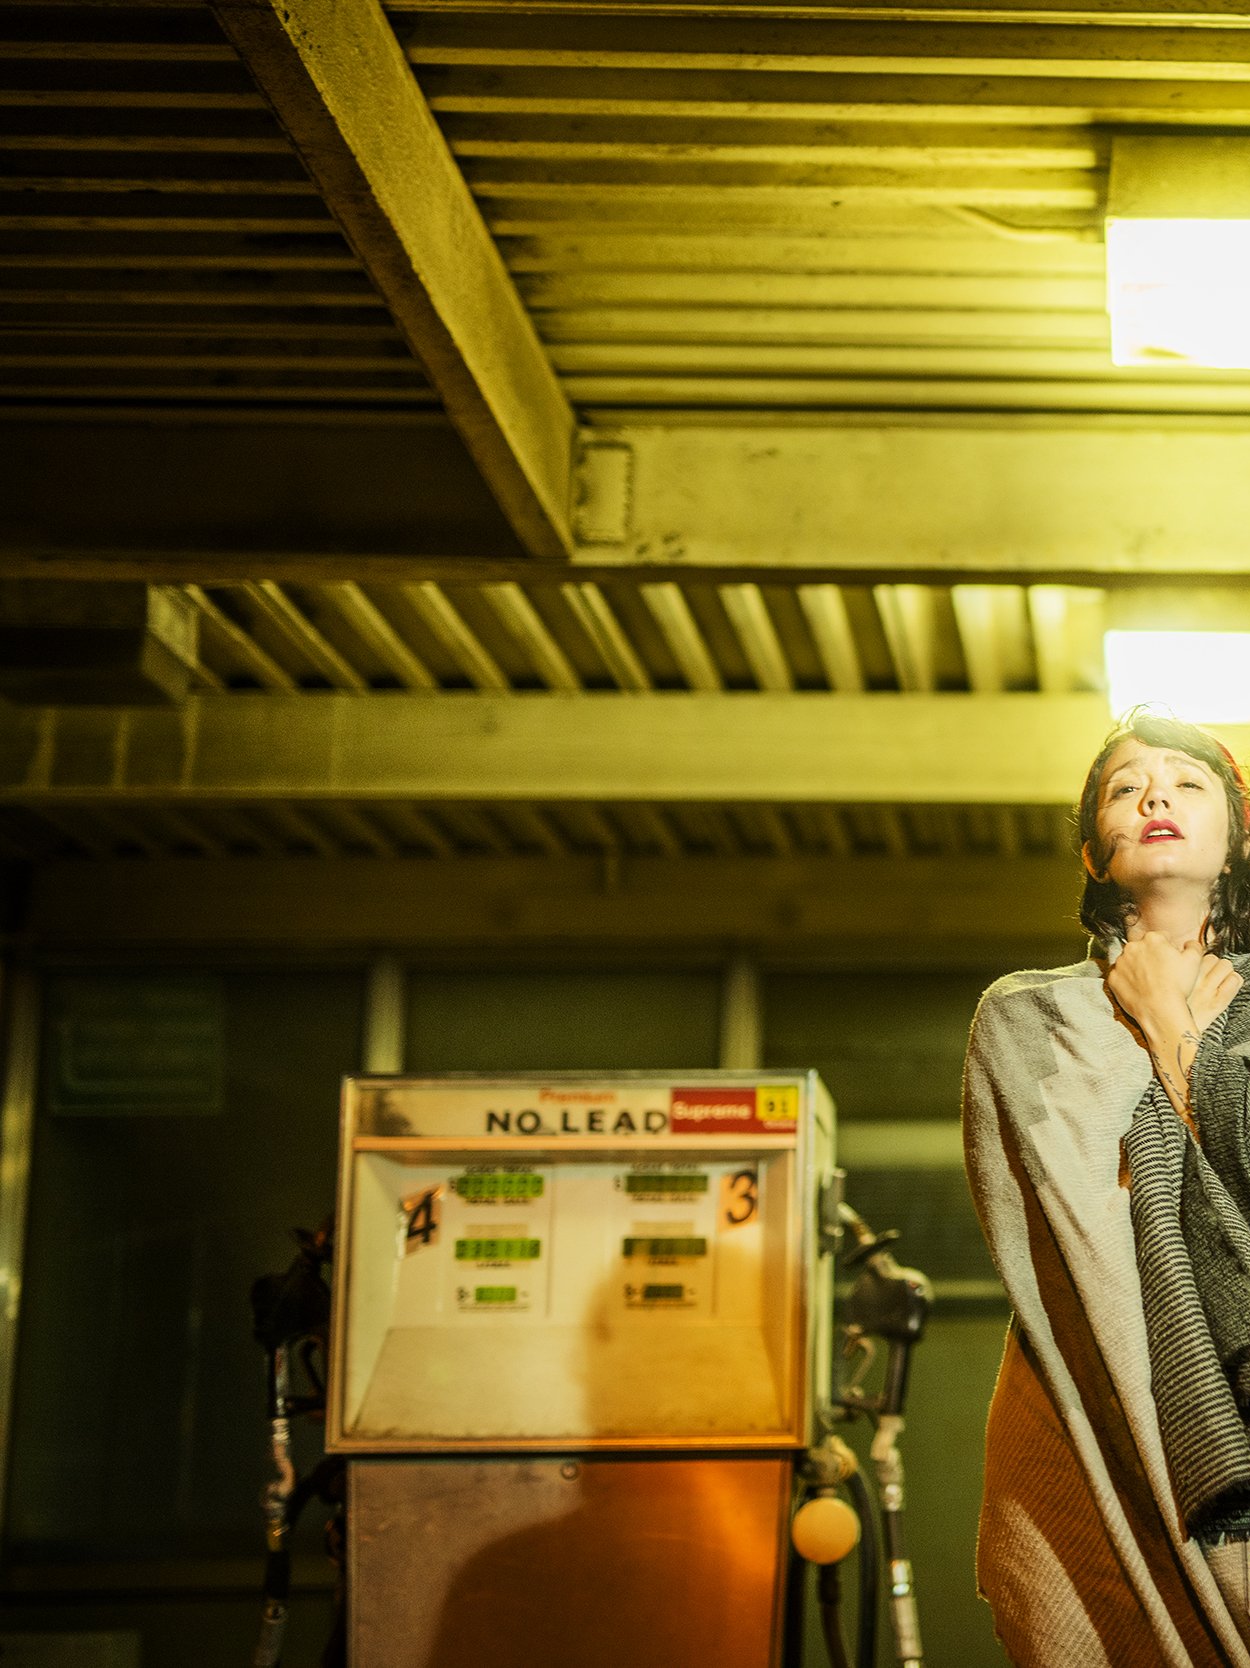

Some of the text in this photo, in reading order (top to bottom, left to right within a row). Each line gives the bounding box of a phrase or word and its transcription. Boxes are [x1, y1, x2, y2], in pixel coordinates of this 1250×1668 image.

[486, 1110, 667, 1134] NO LEAD
[672, 1101, 751, 1122] Supreme
[726, 1170, 758, 1225] 3
[407, 1191, 437, 1244] 4
